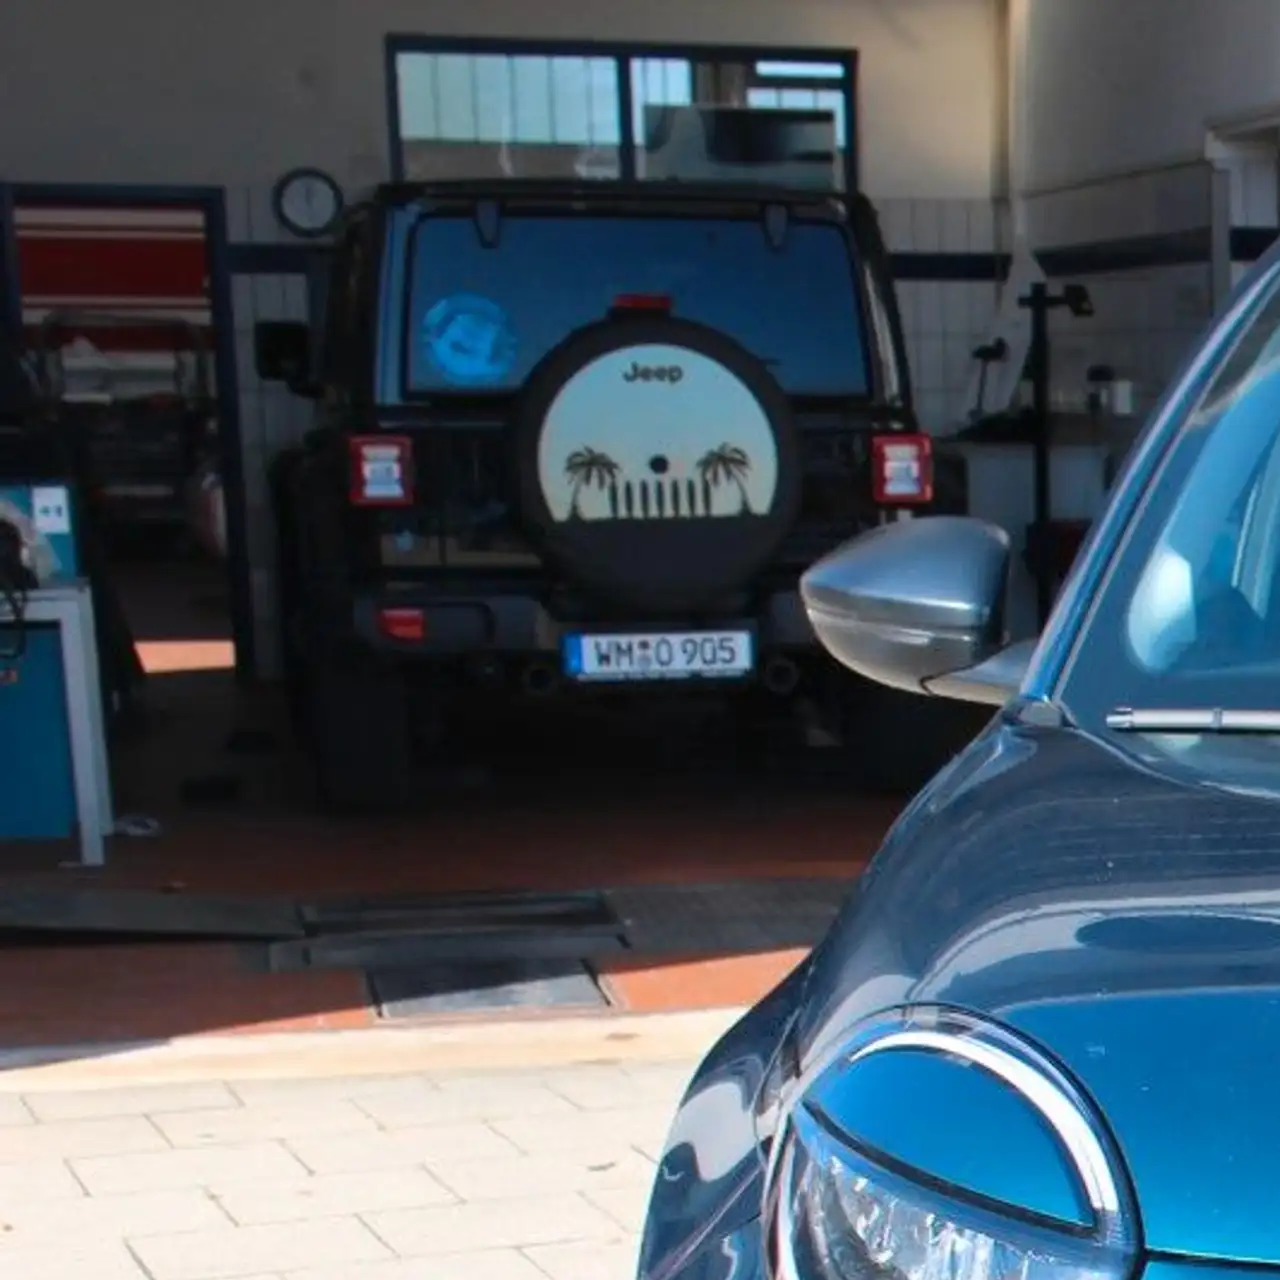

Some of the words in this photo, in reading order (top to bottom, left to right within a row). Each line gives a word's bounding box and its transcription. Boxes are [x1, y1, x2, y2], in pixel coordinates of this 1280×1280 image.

[621, 360, 684, 386] Jeep
[593, 639, 634, 667] WM
[680, 636, 737, 665] 905
